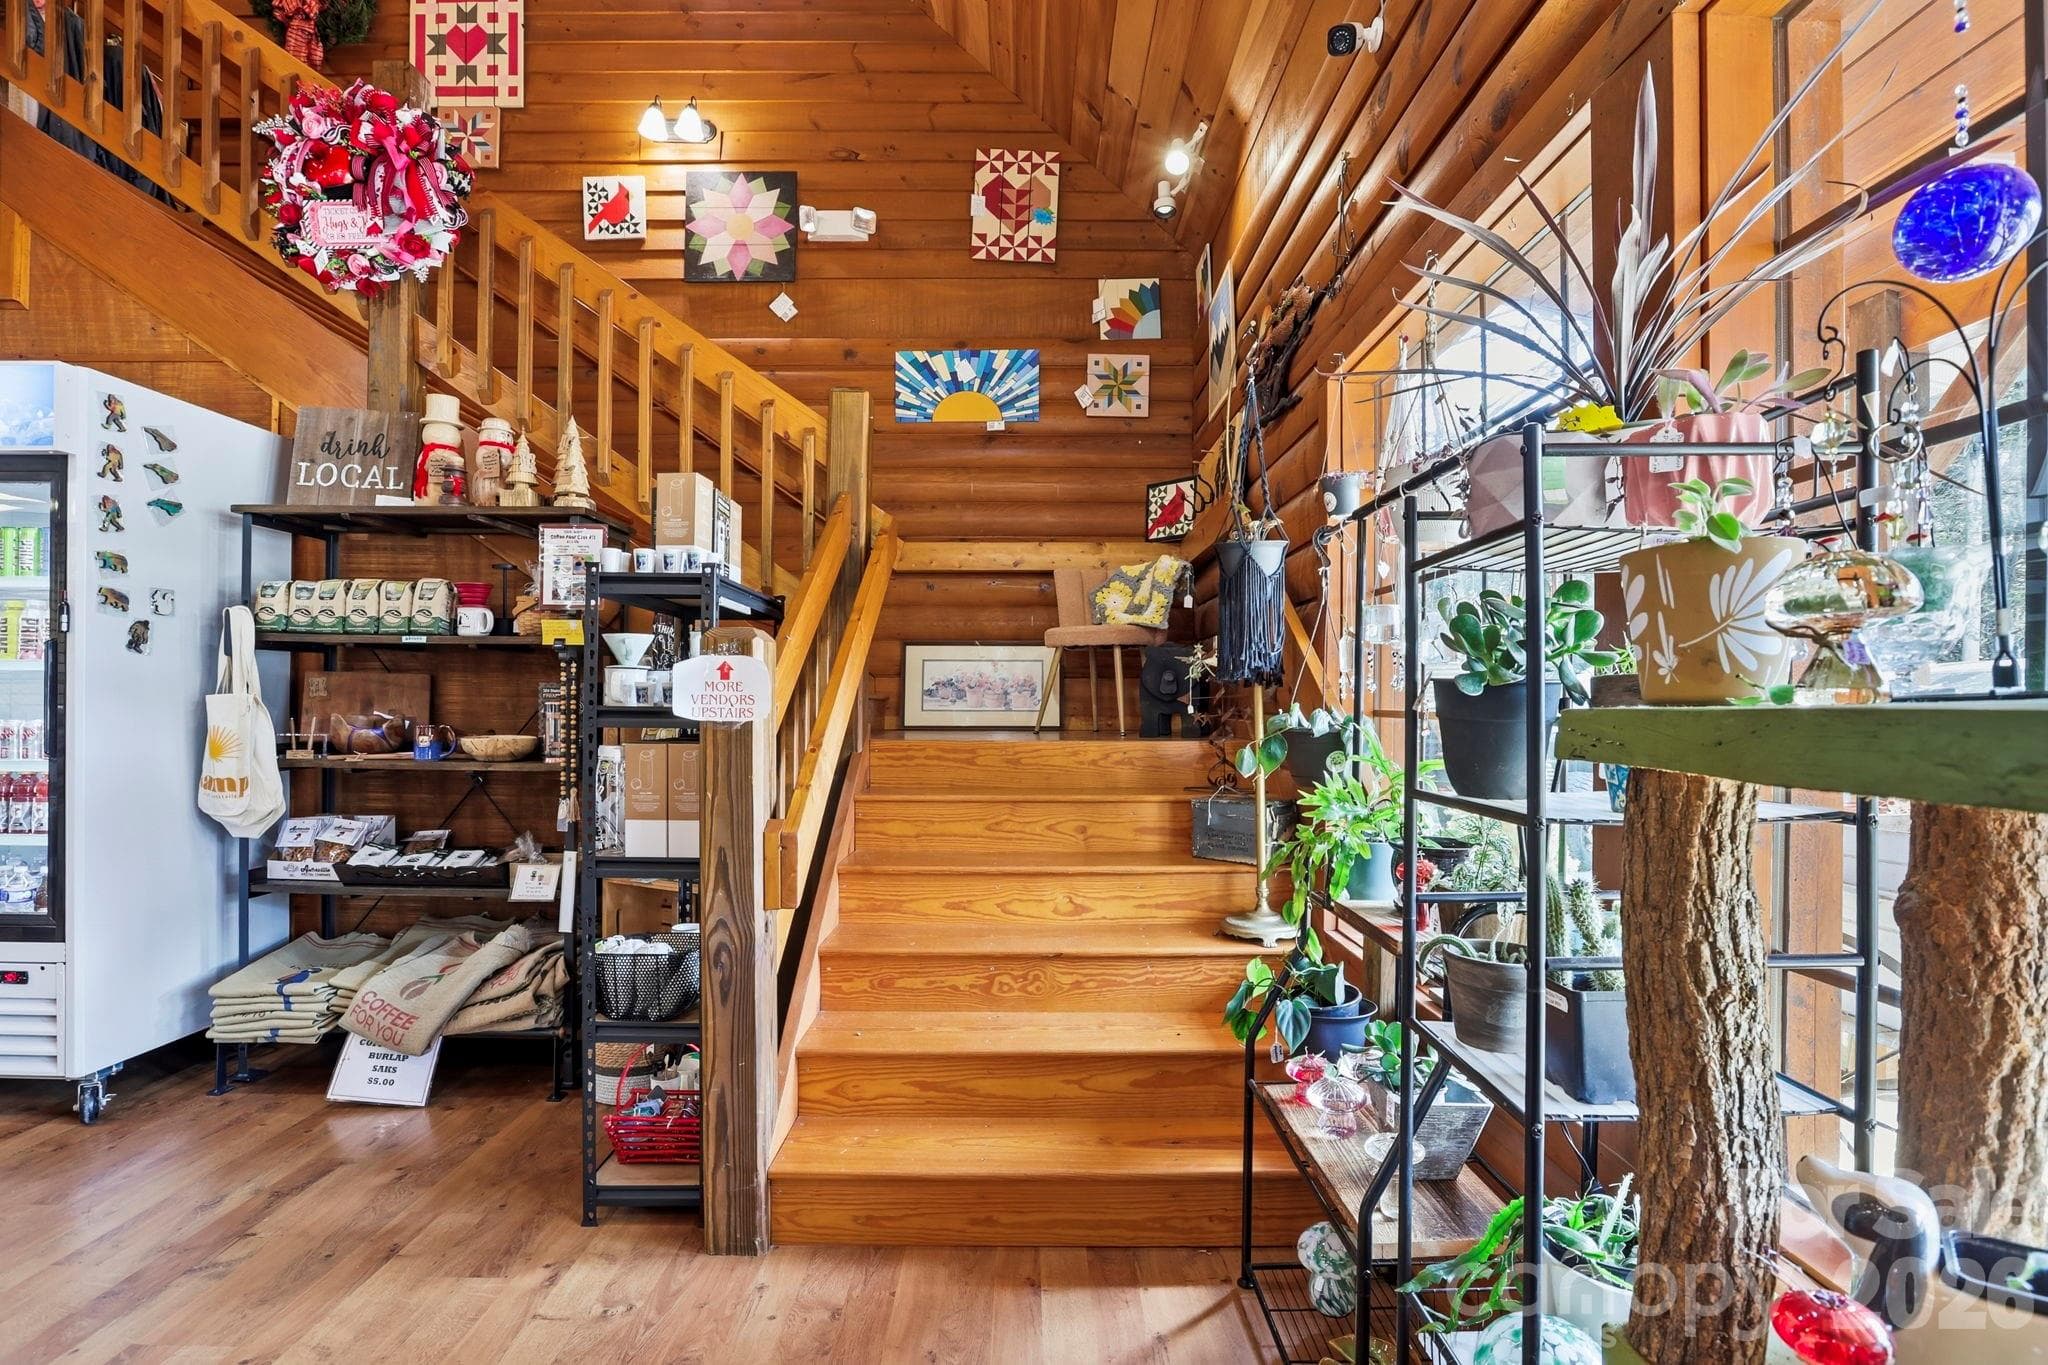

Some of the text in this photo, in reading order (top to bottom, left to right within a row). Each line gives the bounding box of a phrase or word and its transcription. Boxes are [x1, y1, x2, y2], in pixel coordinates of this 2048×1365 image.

[320, 430, 391, 459] drink
[296, 462, 404, 490] LOCAL
[704, 681, 744, 692] MORE
[691, 694, 756, 707] VENDORS
[691, 707, 754, 719] UPSTAIRS
[361, 990, 420, 1030] COFFEE
[350, 1004, 405, 1046] FOR YOU
[368, 1051, 410, 1062] BURLAP
[372, 1064, 398, 1074] SAKS
